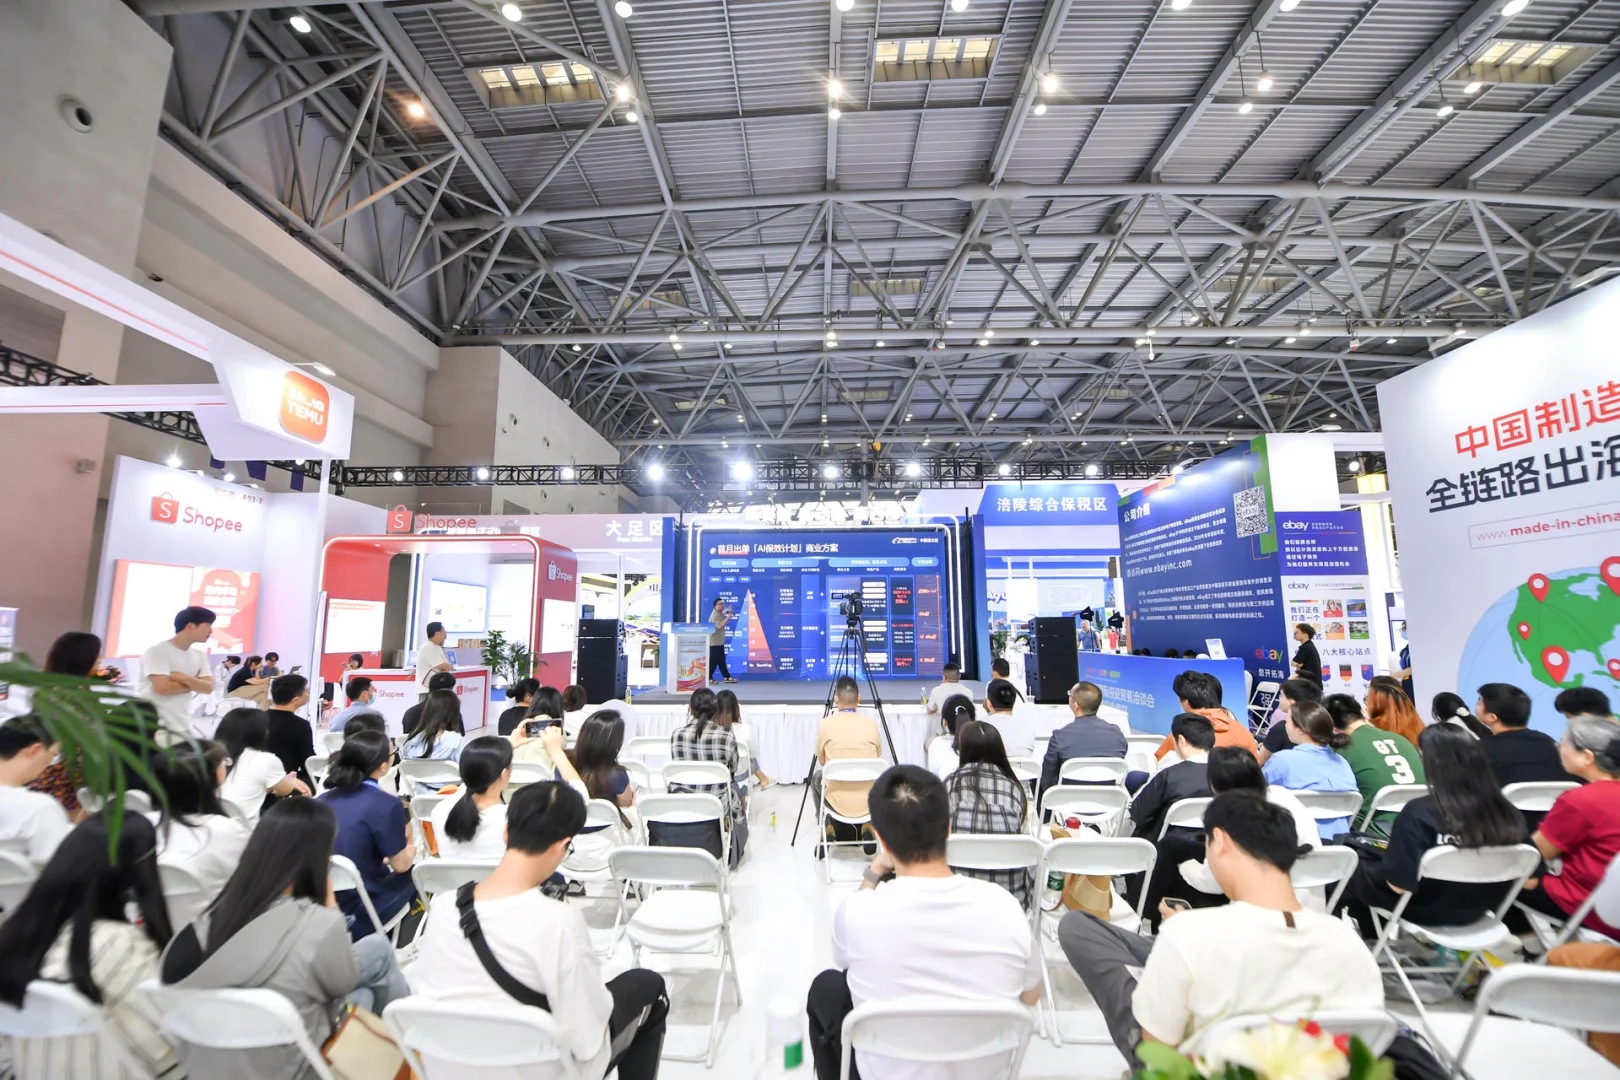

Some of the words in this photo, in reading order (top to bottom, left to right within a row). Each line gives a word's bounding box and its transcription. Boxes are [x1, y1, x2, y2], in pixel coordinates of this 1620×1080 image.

[287, 400, 324, 426] TEMU
[1455, 380, 1620, 458] 中国制造
[1425, 434, 1620, 513] 全链路出海
[997, 496, 1107, 512] 涪陵综合保税区
[183, 506, 243, 532] Shopee
[415, 513, 477, 530] Shopee
[1282, 520, 1309, 531] ebay
[605, 519, 663, 537] 大足区
[556, 567, 573, 583] Shopee
[1287, 581, 1310, 591] ebay
[1290, 606, 1319, 614] 我们正在
[1291, 614, 1320, 622] 打造一个
[1255, 645, 1284, 664] ebay
[1322, 648, 1372, 656] 八大核心站点
[378, 690, 405, 698] Shopee
[1384, 755, 1416, 784] 3
